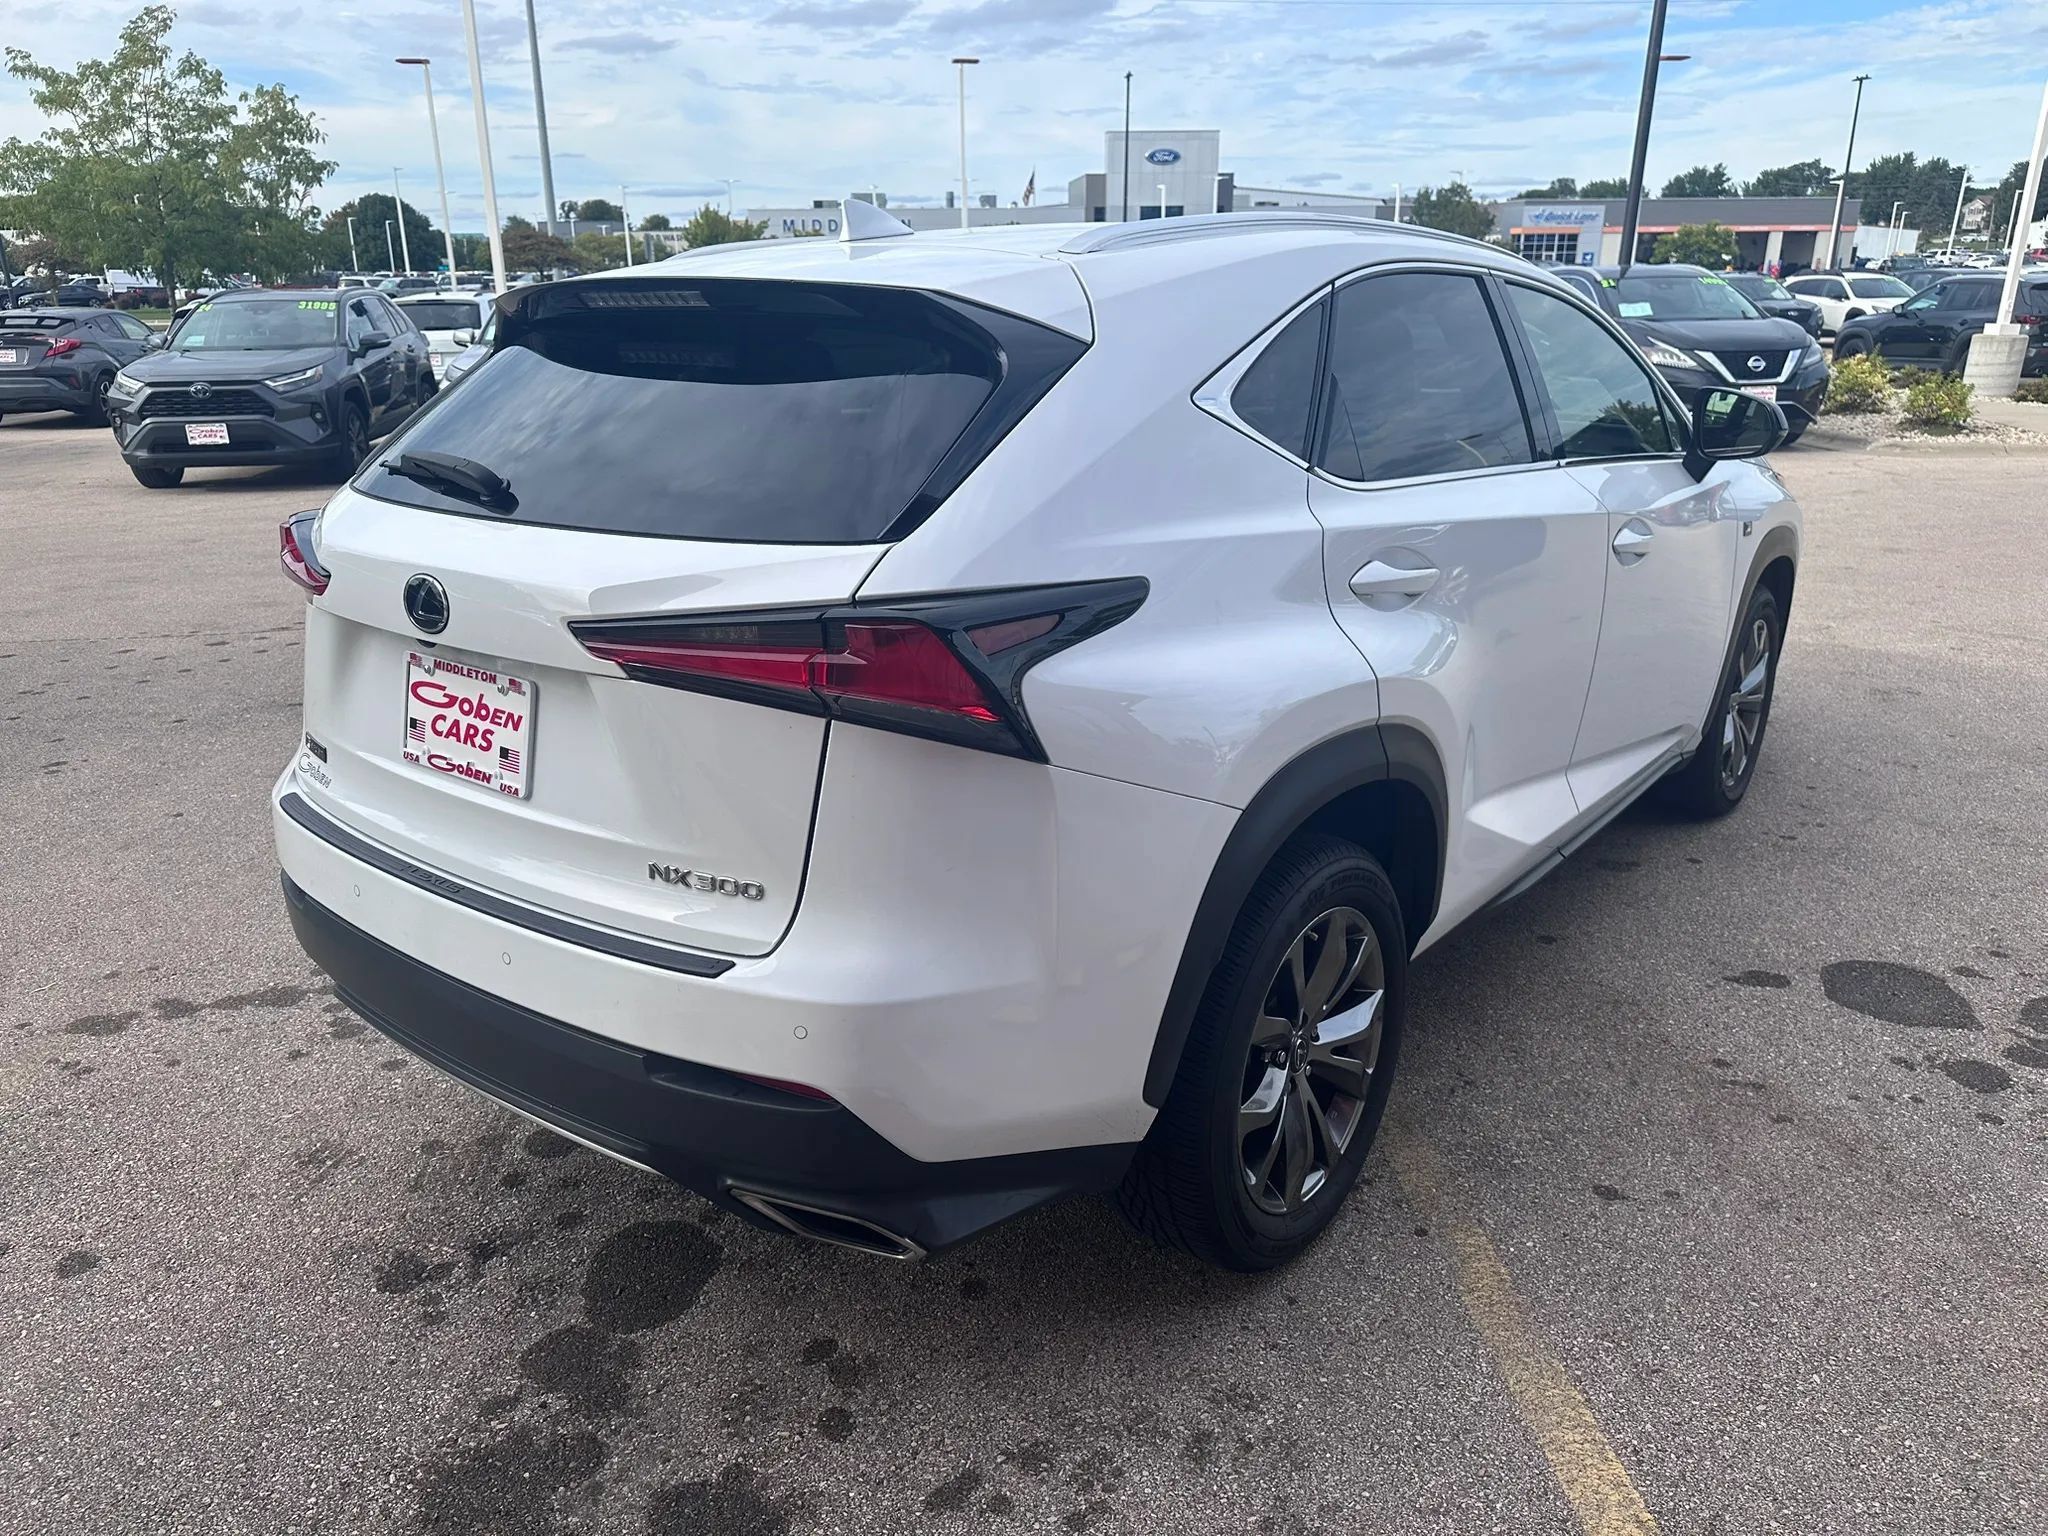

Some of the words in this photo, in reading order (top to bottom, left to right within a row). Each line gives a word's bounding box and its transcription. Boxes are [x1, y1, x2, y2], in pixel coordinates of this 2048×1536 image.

[782, 218, 912, 233] MIDDN
[433, 658, 497, 685] MIDDLETON
[430, 714, 495, 752] CARS
[403, 751, 420, 763] USA
[500, 782, 519, 797] USA
[408, 867, 465, 893] LEXUS
[647, 860, 765, 901] NX300
